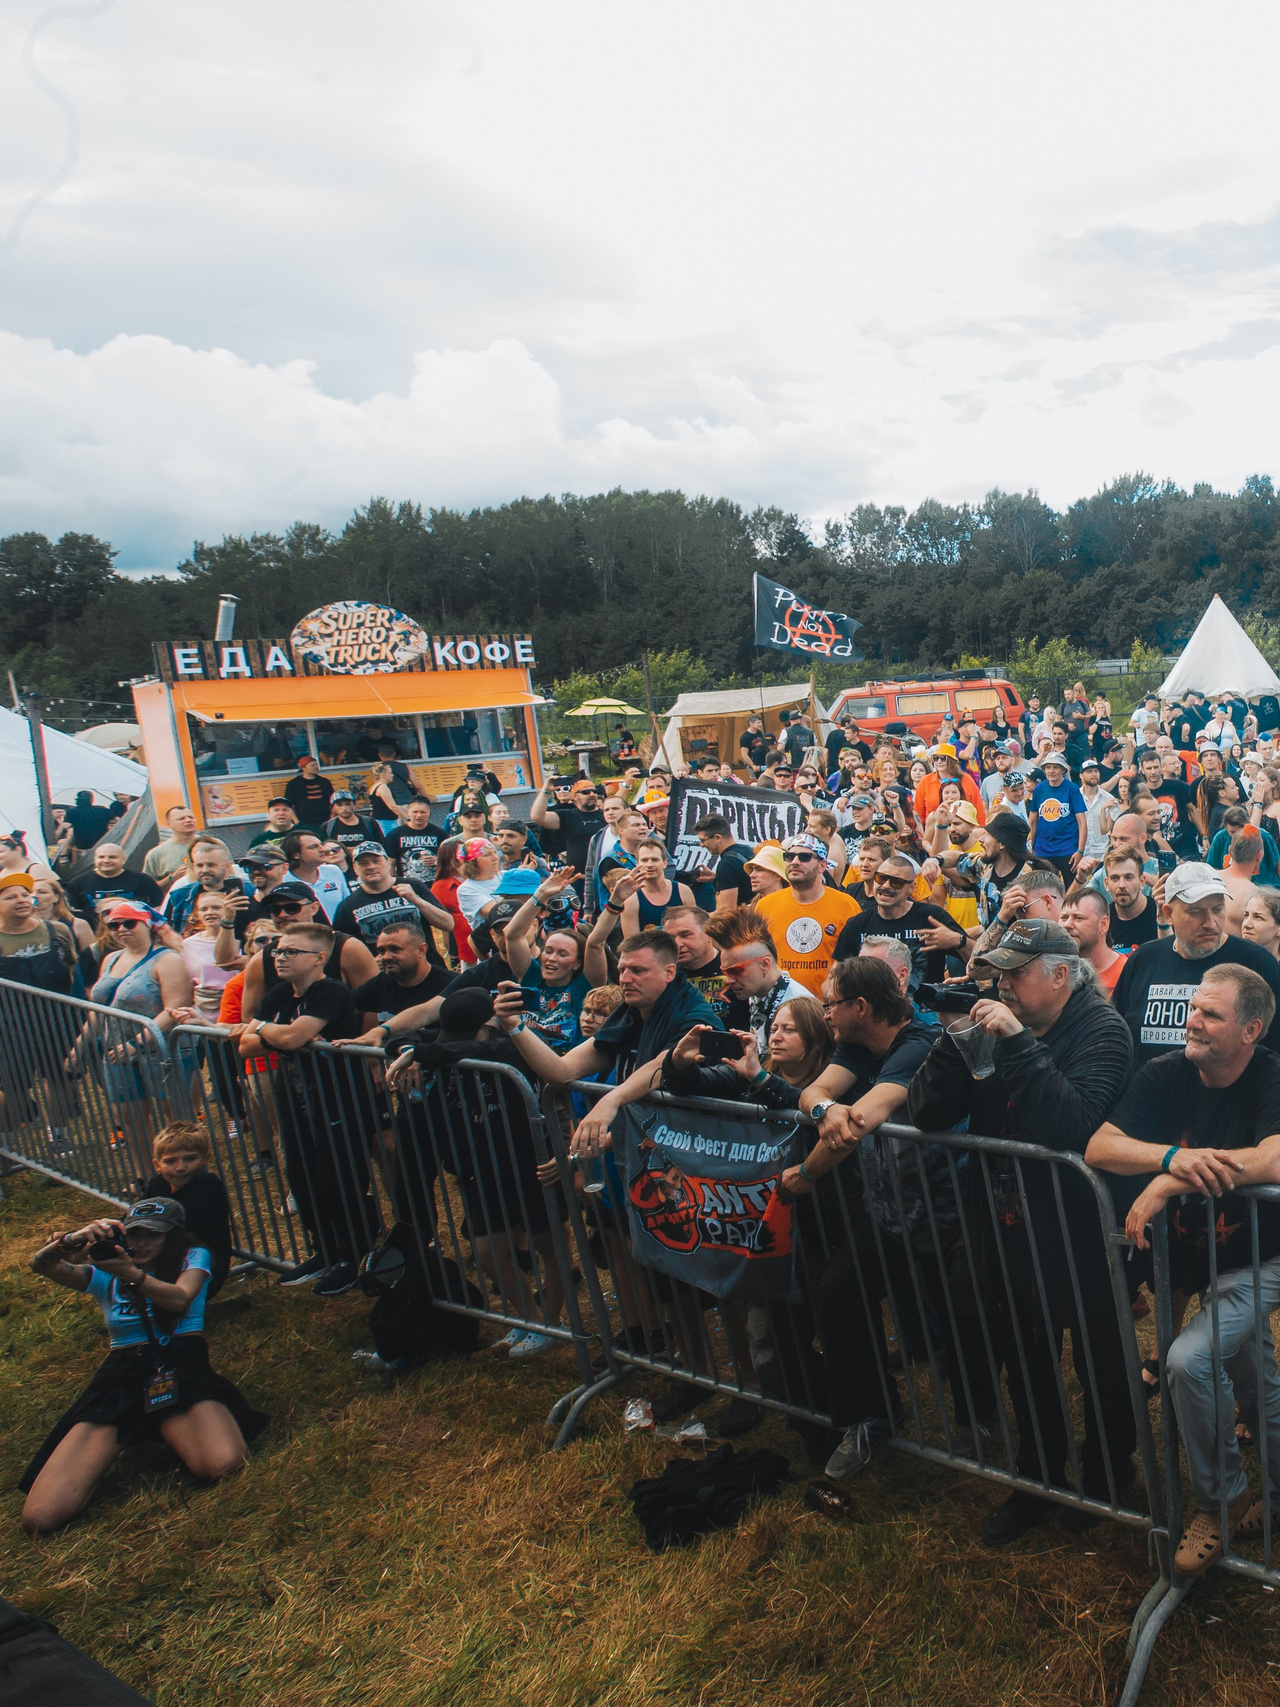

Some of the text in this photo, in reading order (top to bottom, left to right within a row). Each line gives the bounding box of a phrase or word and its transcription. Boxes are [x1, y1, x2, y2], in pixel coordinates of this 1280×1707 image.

[319, 609, 391, 634] SUPER
[332, 626, 387, 646] HERO
[770, 622, 853, 656] Dead
[174, 646, 293, 677] ЕДА
[326, 642, 396, 665] TRUCK
[433, 640, 535, 664] КОФЕ
[384, 897, 402, 909] LIKE
[1149, 986, 1174, 997] ДАВАЙ
[1176, 987, 1188, 997] ЖЕ
[654, 1124, 692, 1151] Свой
[728, 1142, 757, 1163] для
